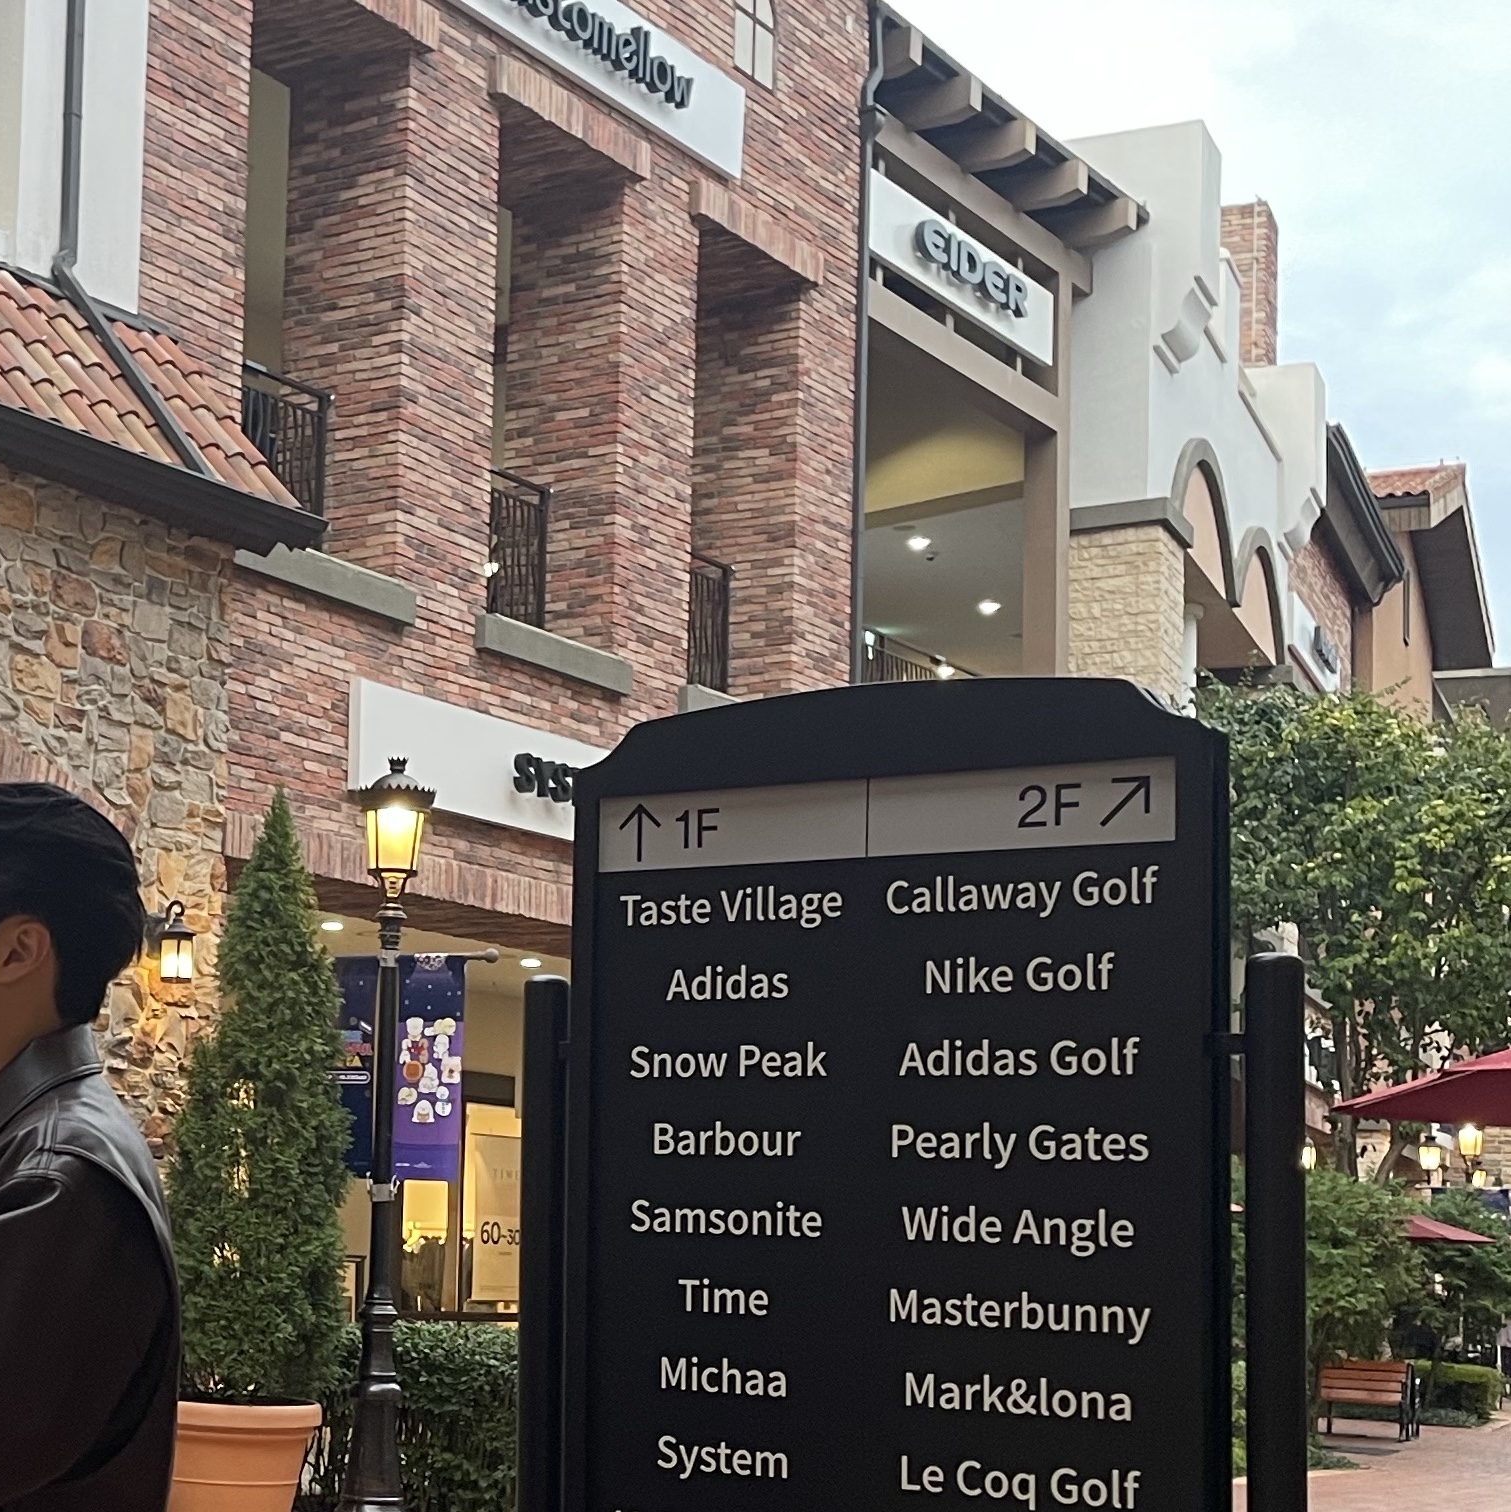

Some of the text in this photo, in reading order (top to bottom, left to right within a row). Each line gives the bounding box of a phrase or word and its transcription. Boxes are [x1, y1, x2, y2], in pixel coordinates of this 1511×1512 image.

[914, 219, 1029, 319] EIDER
[513, 752, 579, 803] SYS
[1017, 782, 1082, 829] 2F
[675, 807, 720, 849] 1F
[619, 885, 843, 929] Taste Village
[886, 865, 1159, 918] Callaway Golf
[665, 964, 789, 1001] Adidas
[925, 951, 1115, 994] Nike Golf
[629, 1041, 827, 1078] Snow Peak
[898, 1036, 1141, 1077] Adidas Golf
[653, 1120, 802, 1157] Barbour
[891, 1121, 1149, 1170] Pearly Gates
[630, 1199, 822, 1238] Samsonite
[901, 1205, 1135, 1257] Wide Angle
[678, 1277, 769, 1316] Time
[889, 1288, 1151, 1345] Masterbunny
[661, 1356, 787, 1398] Michaa
[657, 1435, 788, 1480] System
[901, 1455, 1142, 1511] Le Coq Golf
